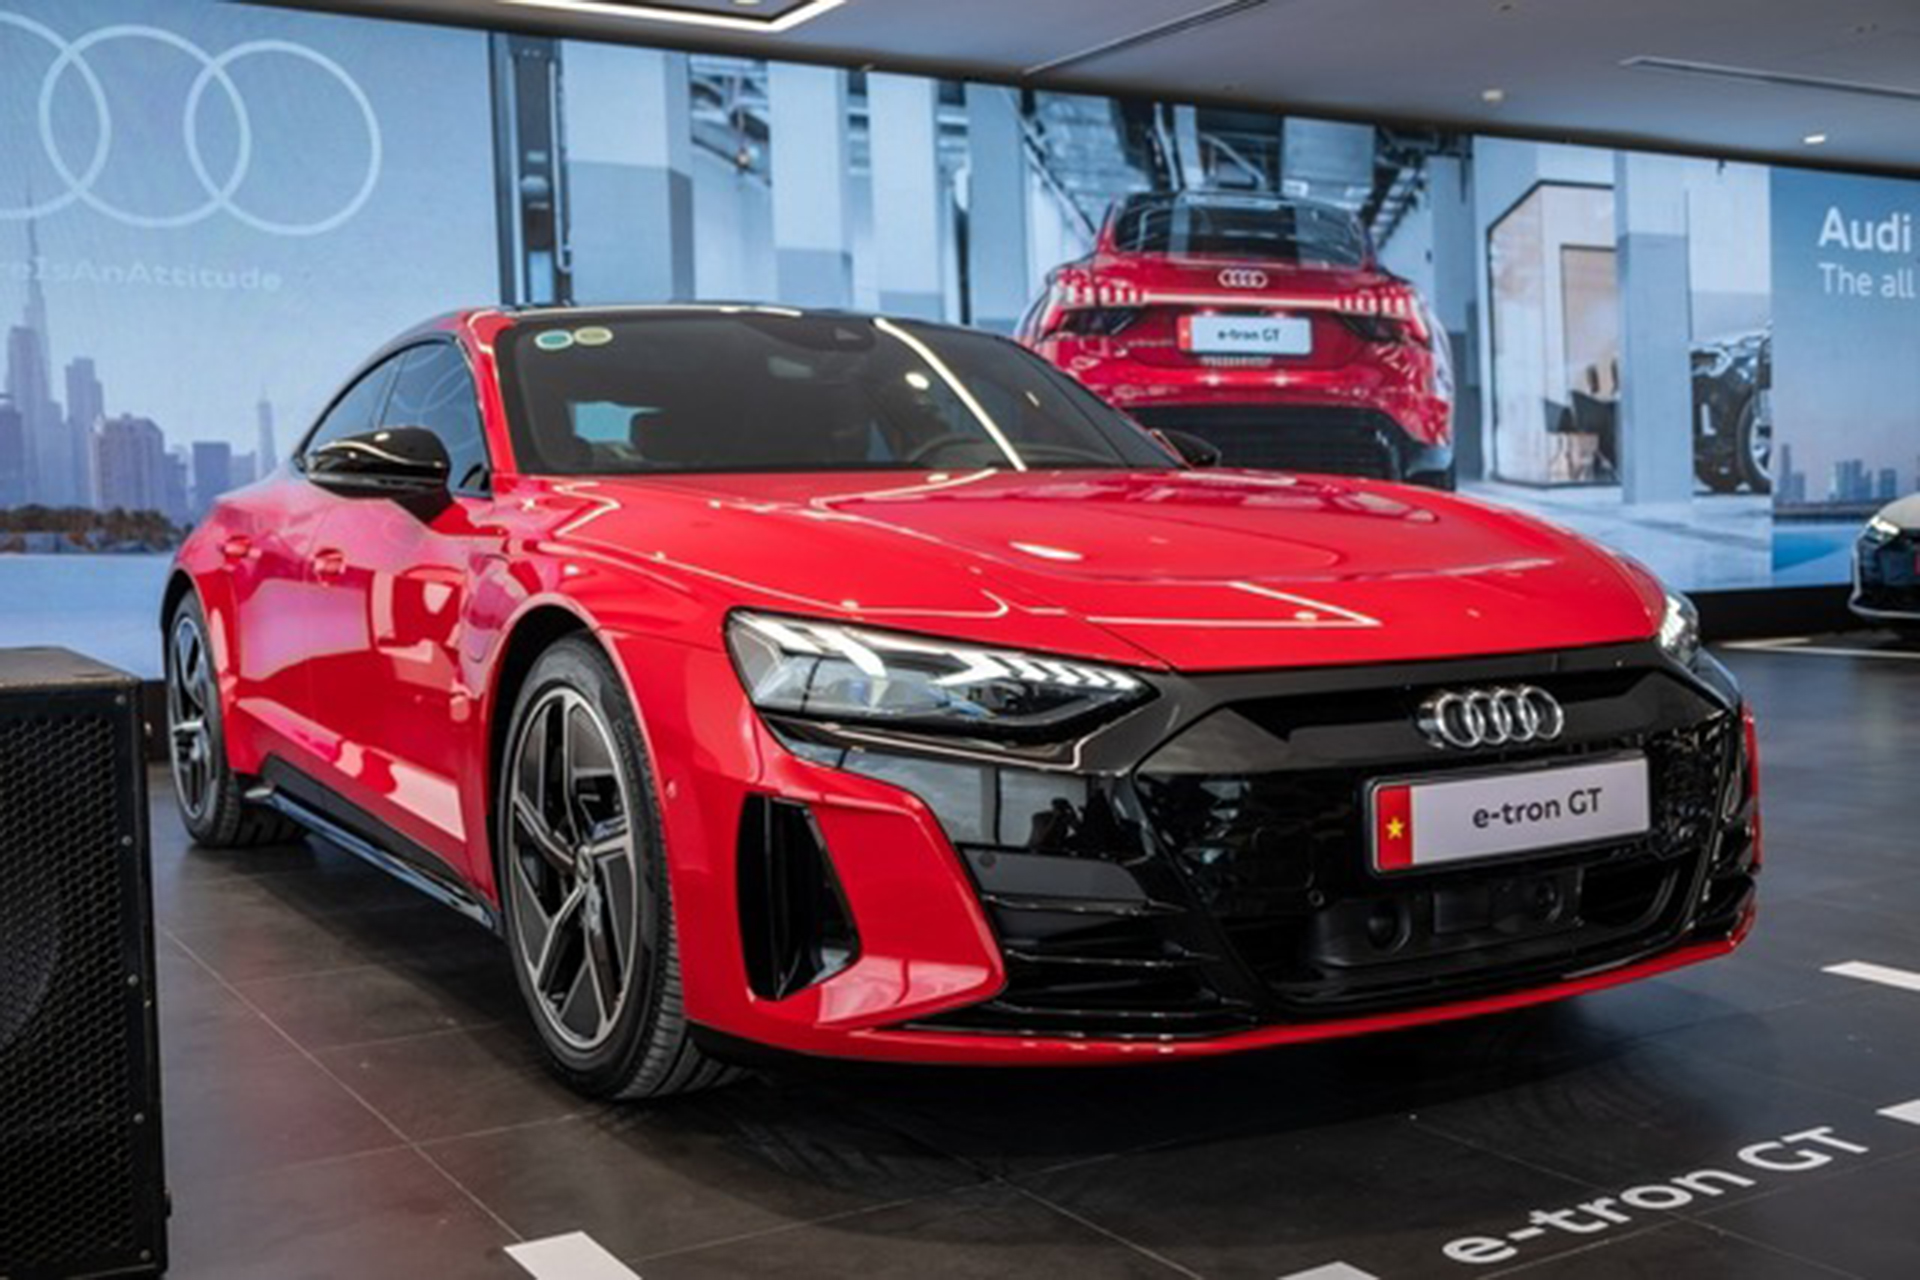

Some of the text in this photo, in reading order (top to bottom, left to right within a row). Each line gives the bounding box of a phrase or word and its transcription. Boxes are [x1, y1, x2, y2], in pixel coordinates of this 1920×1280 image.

[1818, 206, 1911, 253] Audi
[1818, 262, 1914, 298] The all
[1262, 328, 1280, 341] GT
[1472, 788, 1602, 828] e-tron GT
[1442, 1126, 1870, 1264] e-tron GT
